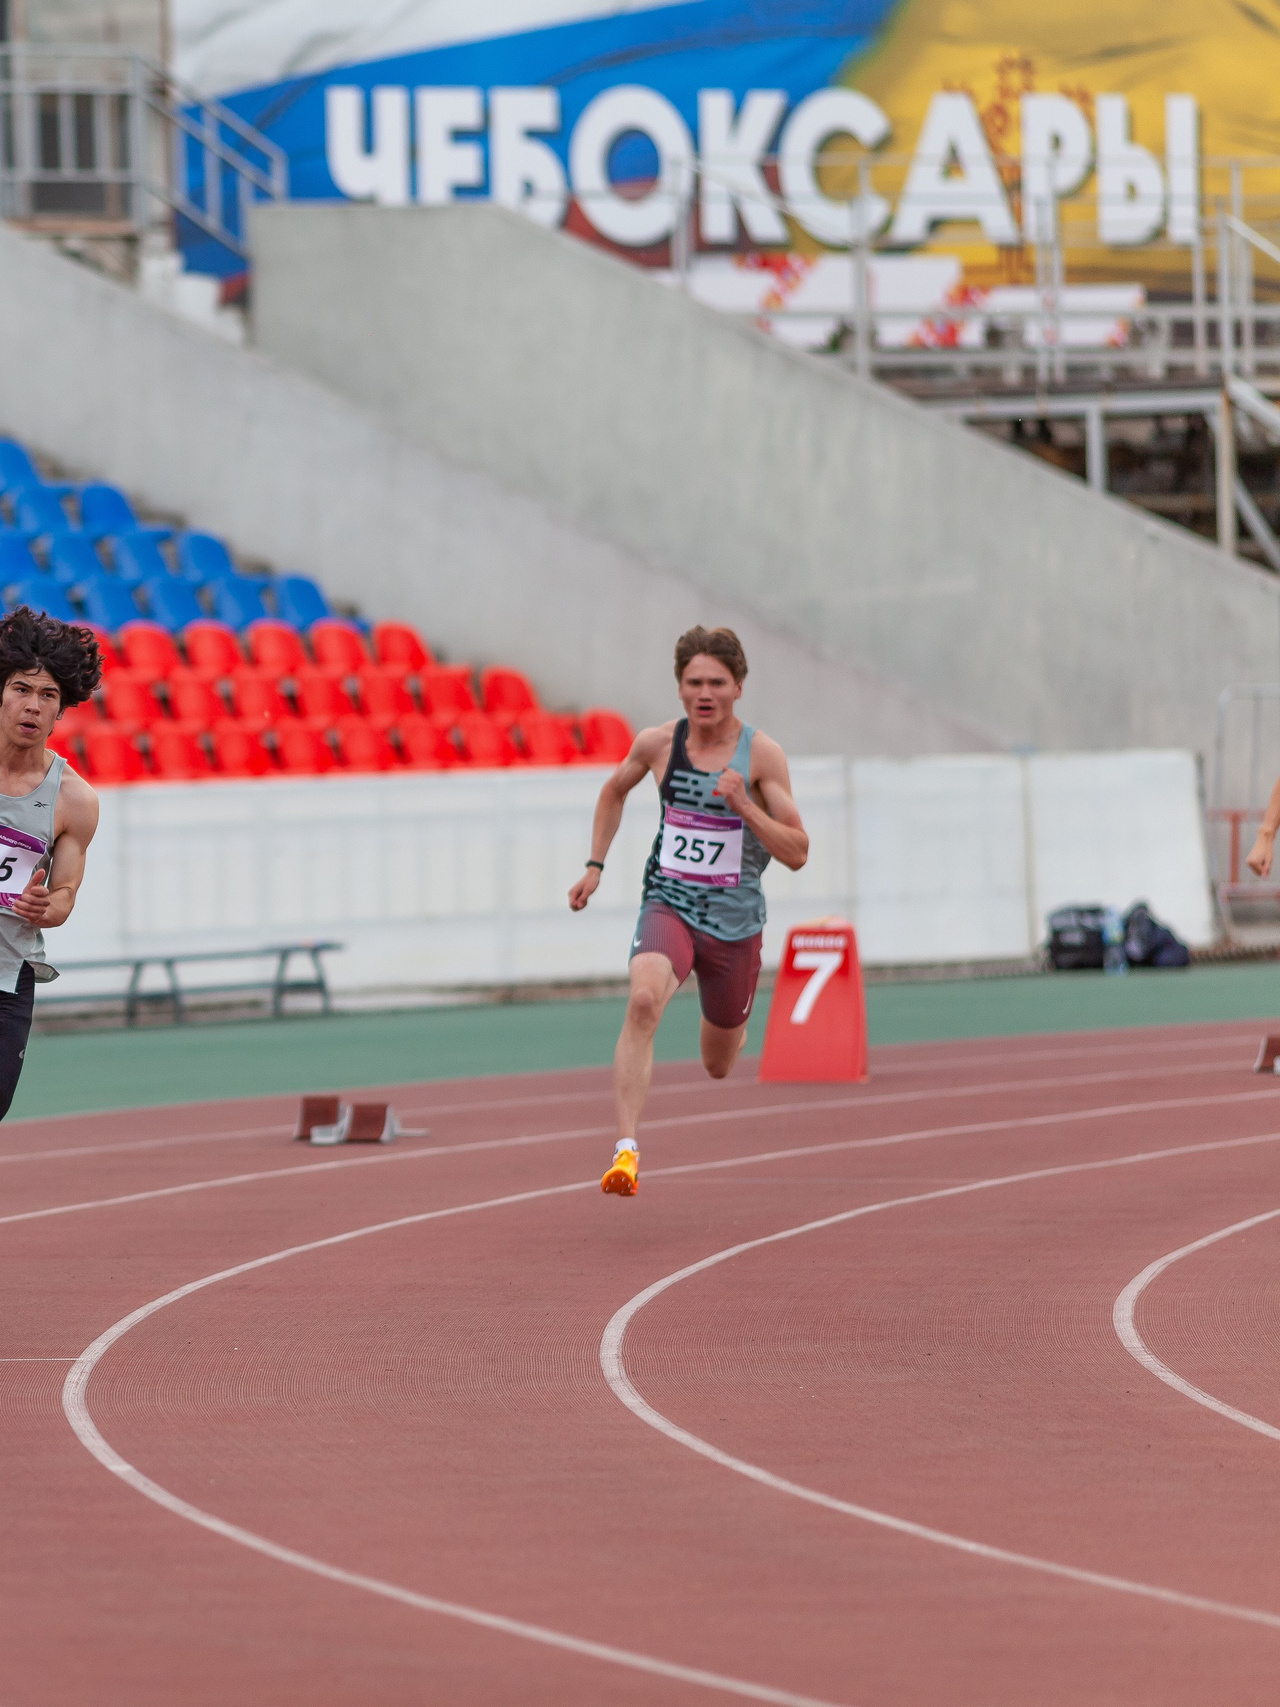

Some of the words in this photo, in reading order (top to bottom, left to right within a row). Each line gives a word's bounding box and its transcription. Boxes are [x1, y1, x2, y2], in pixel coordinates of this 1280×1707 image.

[324, 84, 1200, 247] ЧЕБОКСАРЫ
[673, 834, 725, 865] 257
[790, 951, 844, 1025] 7
